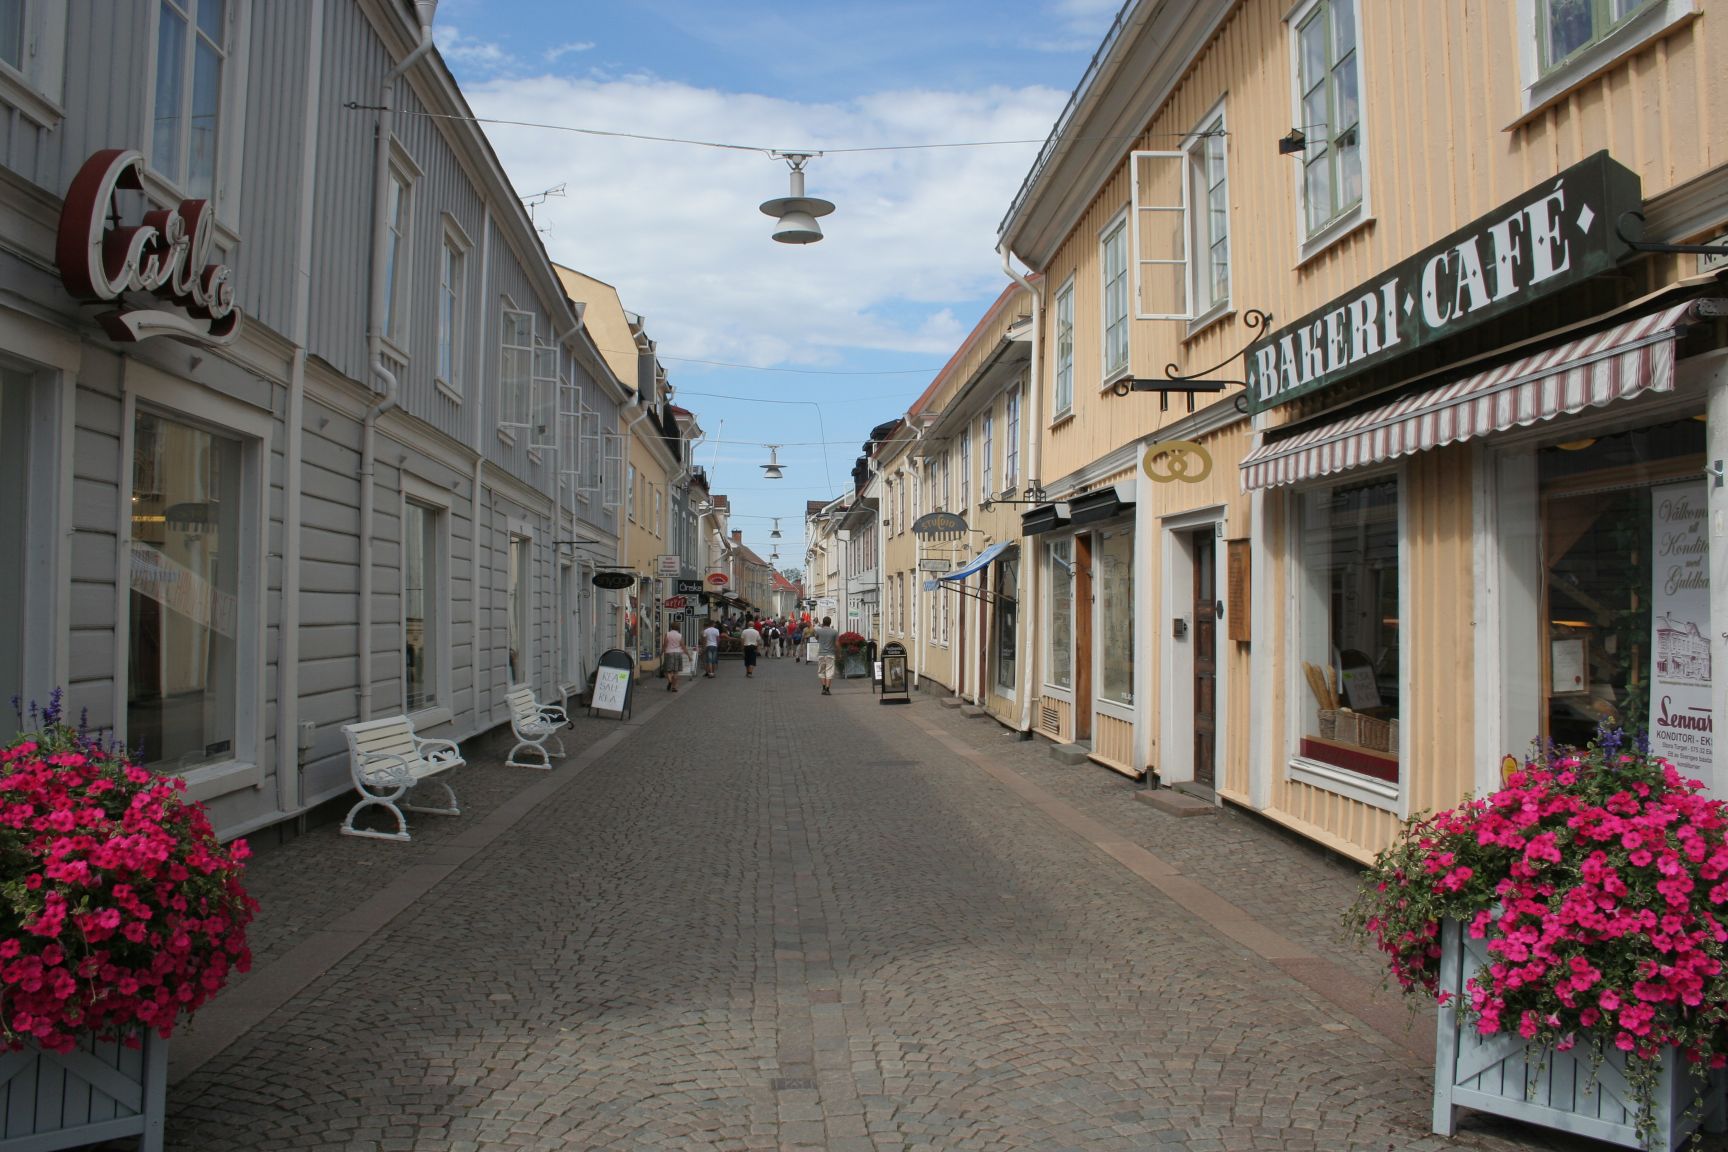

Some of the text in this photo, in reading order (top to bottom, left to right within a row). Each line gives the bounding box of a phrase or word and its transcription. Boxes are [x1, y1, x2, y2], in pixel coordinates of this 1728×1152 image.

[1255, 178, 1570, 402] BAKERI CAFÉ
[1659, 496, 1708, 522] Välkom
[1656, 730, 1695, 744] KONDITORI
